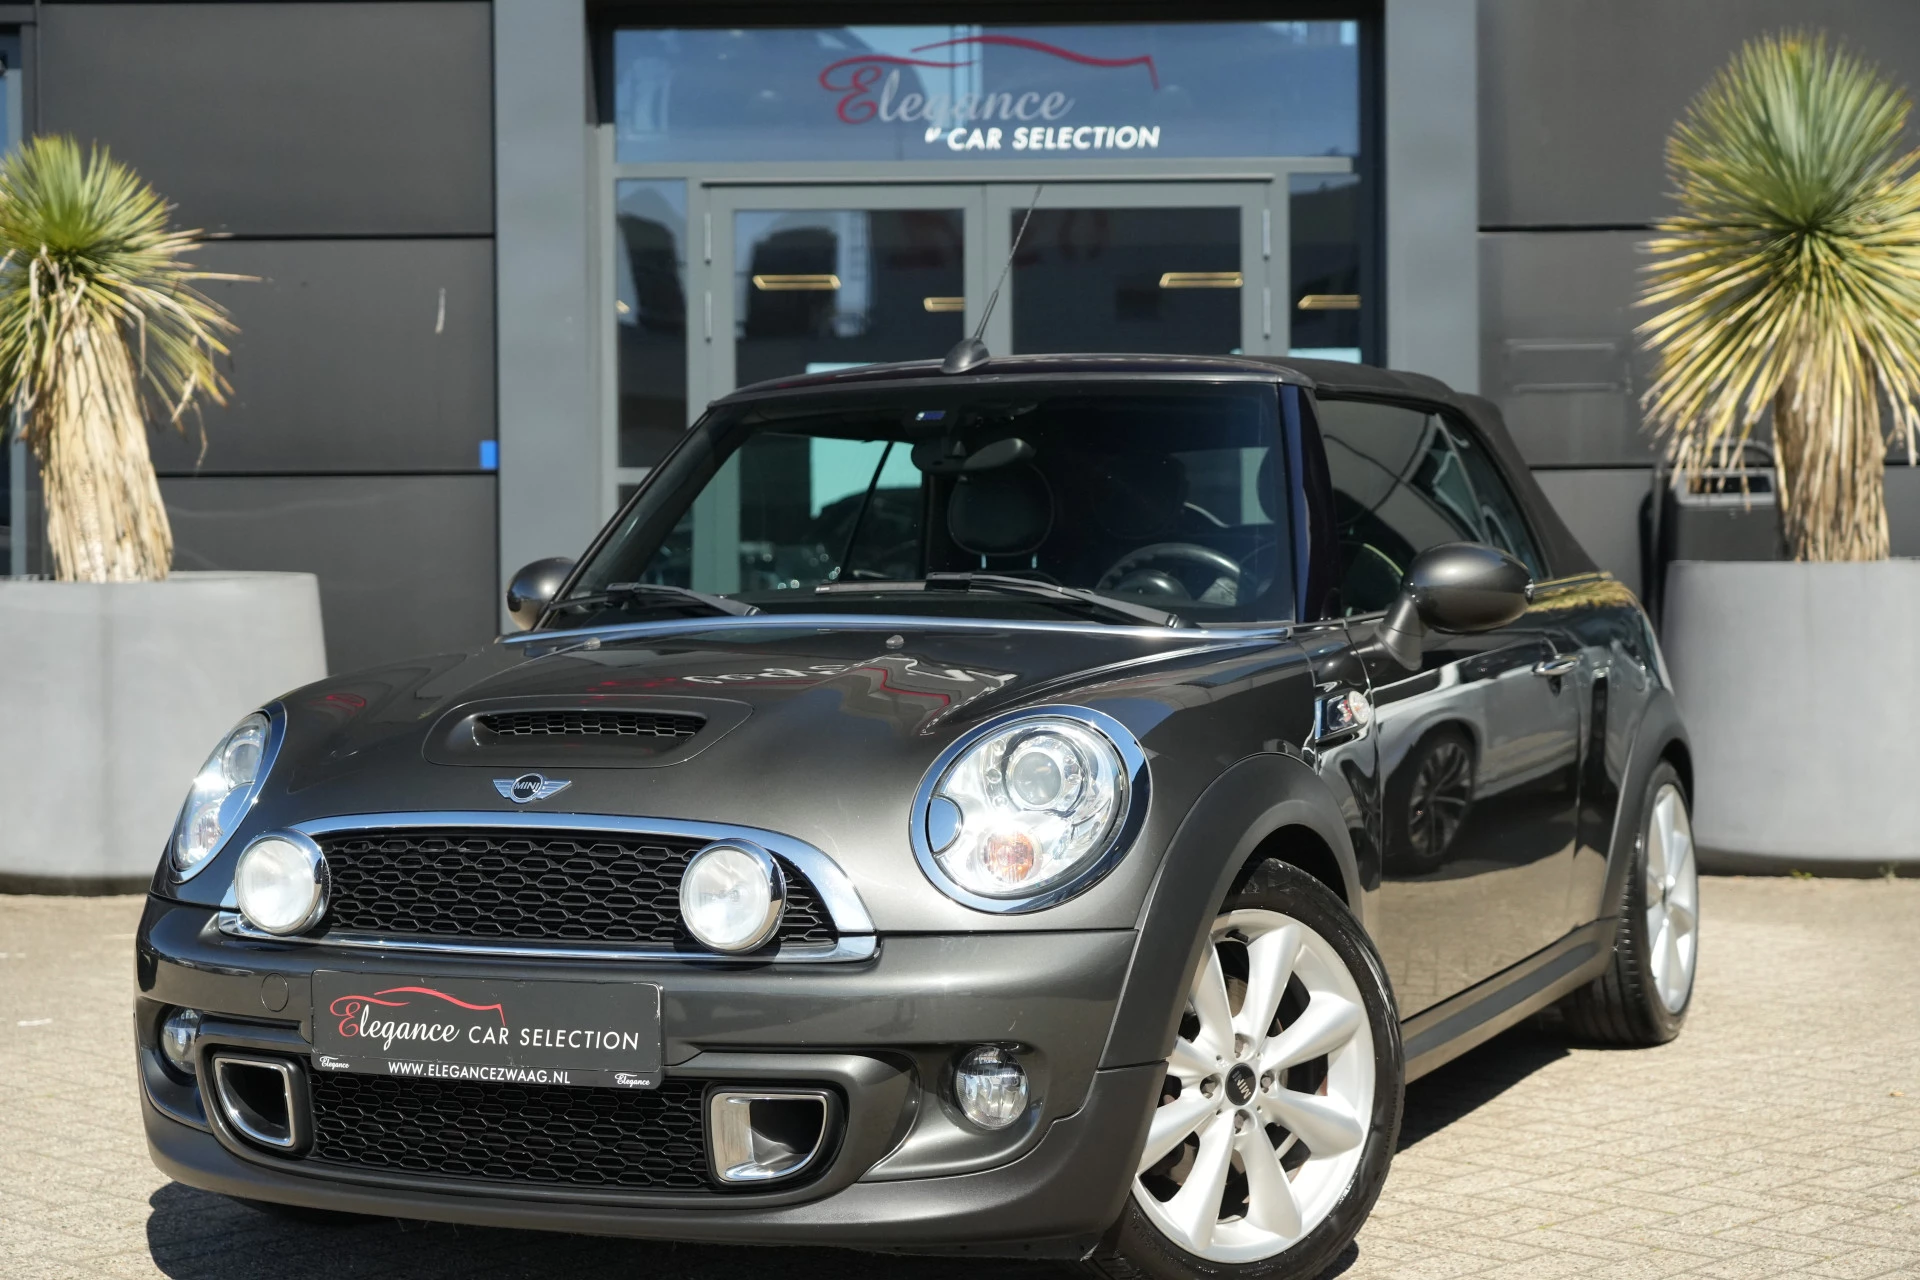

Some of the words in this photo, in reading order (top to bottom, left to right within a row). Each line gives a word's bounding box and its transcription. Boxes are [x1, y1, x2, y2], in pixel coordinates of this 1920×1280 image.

[818, 53, 1077, 144] Elegance
[946, 126, 1004, 153] CAR
[1011, 125, 1161, 151] SELECTION
[514, 780, 541, 791] MINI
[329, 994, 461, 1052] Elegance
[468, 1025, 510, 1046] CAR
[519, 1027, 640, 1051] SELECTION
[319, 1055, 351, 1071] Elegance
[387, 1061, 571, 1085] WWW.ELEGANCEZWAAG.NL
[614, 1072, 651, 1088] Elegance
